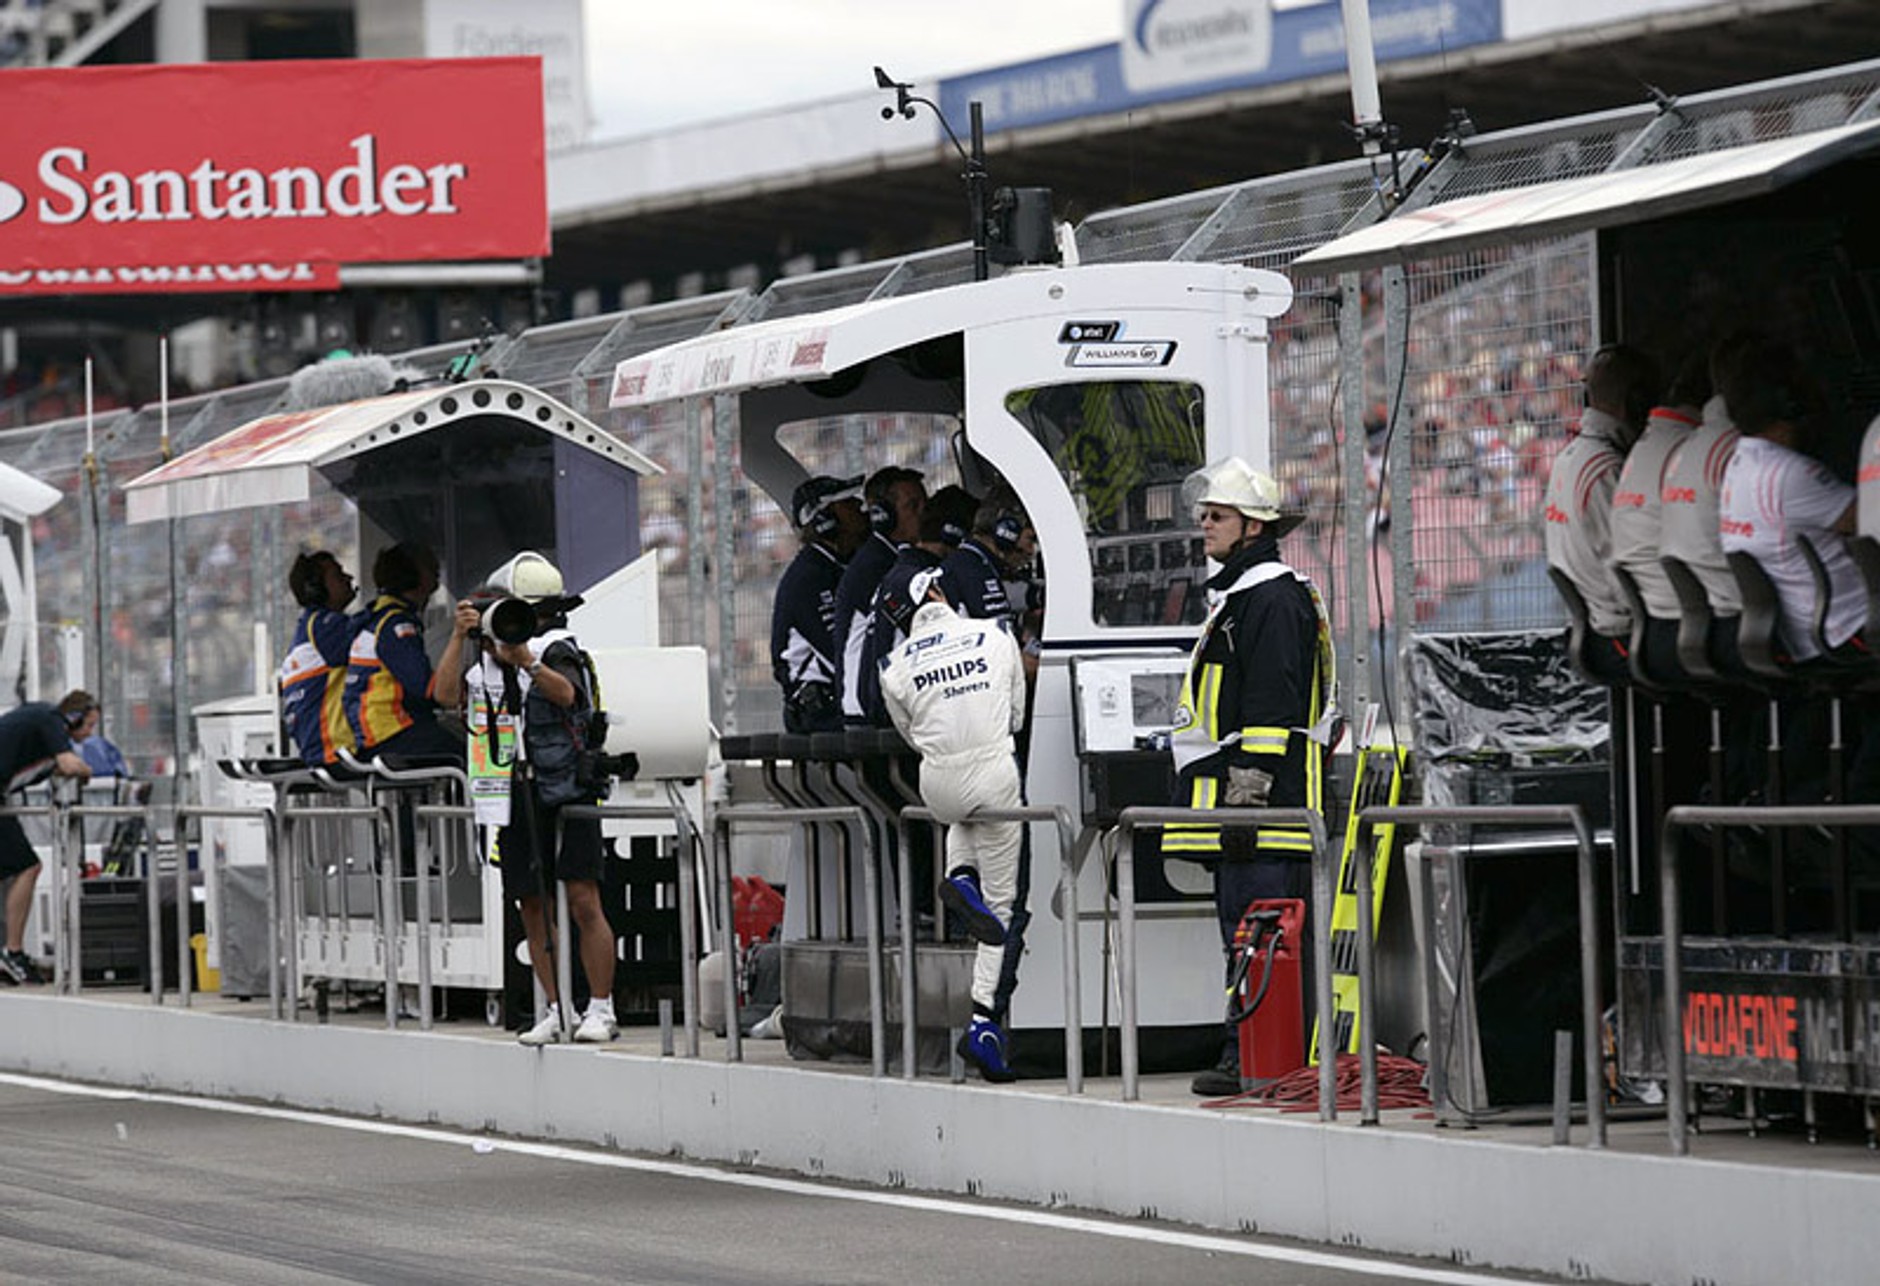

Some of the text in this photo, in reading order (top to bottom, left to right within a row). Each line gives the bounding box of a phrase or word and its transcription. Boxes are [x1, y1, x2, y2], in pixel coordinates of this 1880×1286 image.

[37, 134, 467, 225] Santander
[1085, 350, 1138, 359] WILLIAMS
[913, 657, 988, 691] PHILIPS
[943, 681, 990, 699] Shavers
[1682, 991, 1799, 1061] VODAFONE
